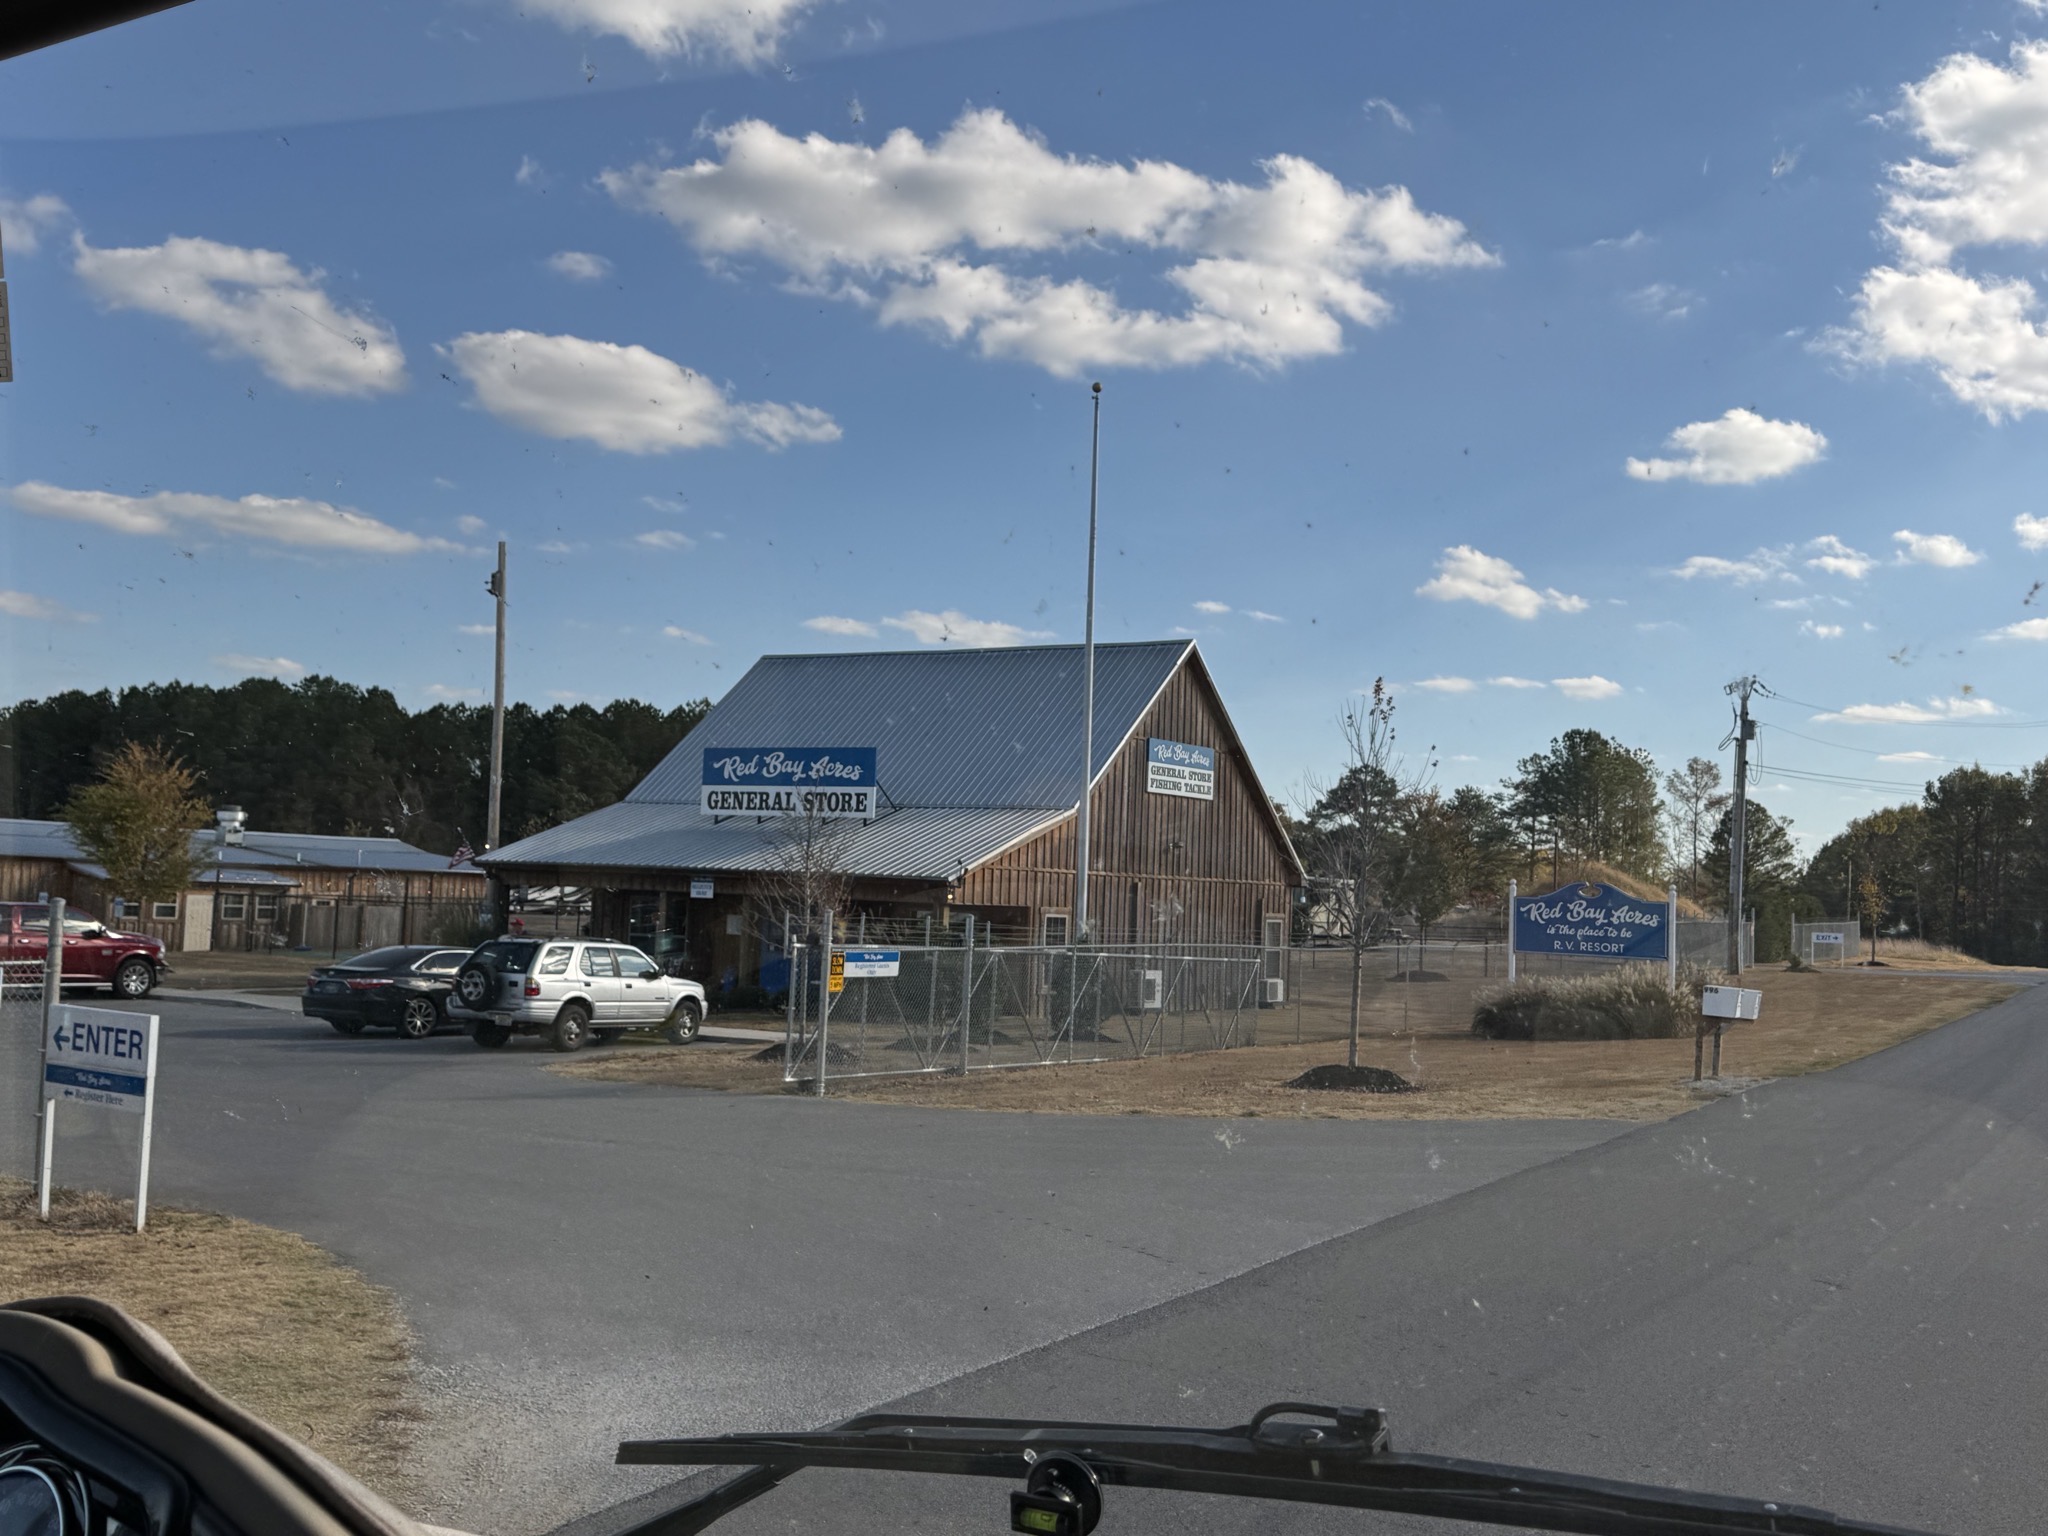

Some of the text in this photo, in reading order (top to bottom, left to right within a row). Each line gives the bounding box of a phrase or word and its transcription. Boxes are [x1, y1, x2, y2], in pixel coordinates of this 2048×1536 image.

[1154, 744, 1210, 766] Red Bay Acres
[713, 751, 863, 782] Red Bay Acres
[1151, 765, 1212, 783] GENERAL STORE
[1150, 778, 1212, 795] FISHING TACKLE
[707, 790, 868, 813] GENERAL STORE
[1520, 900, 1661, 927] Red Bay Acres
[1546, 924, 1632, 940] is the place to be
[1580, 942, 1625, 953] RESORT
[72, 1023, 143, 1060] ENTER
[75, 1089, 123, 1105] Register Here
